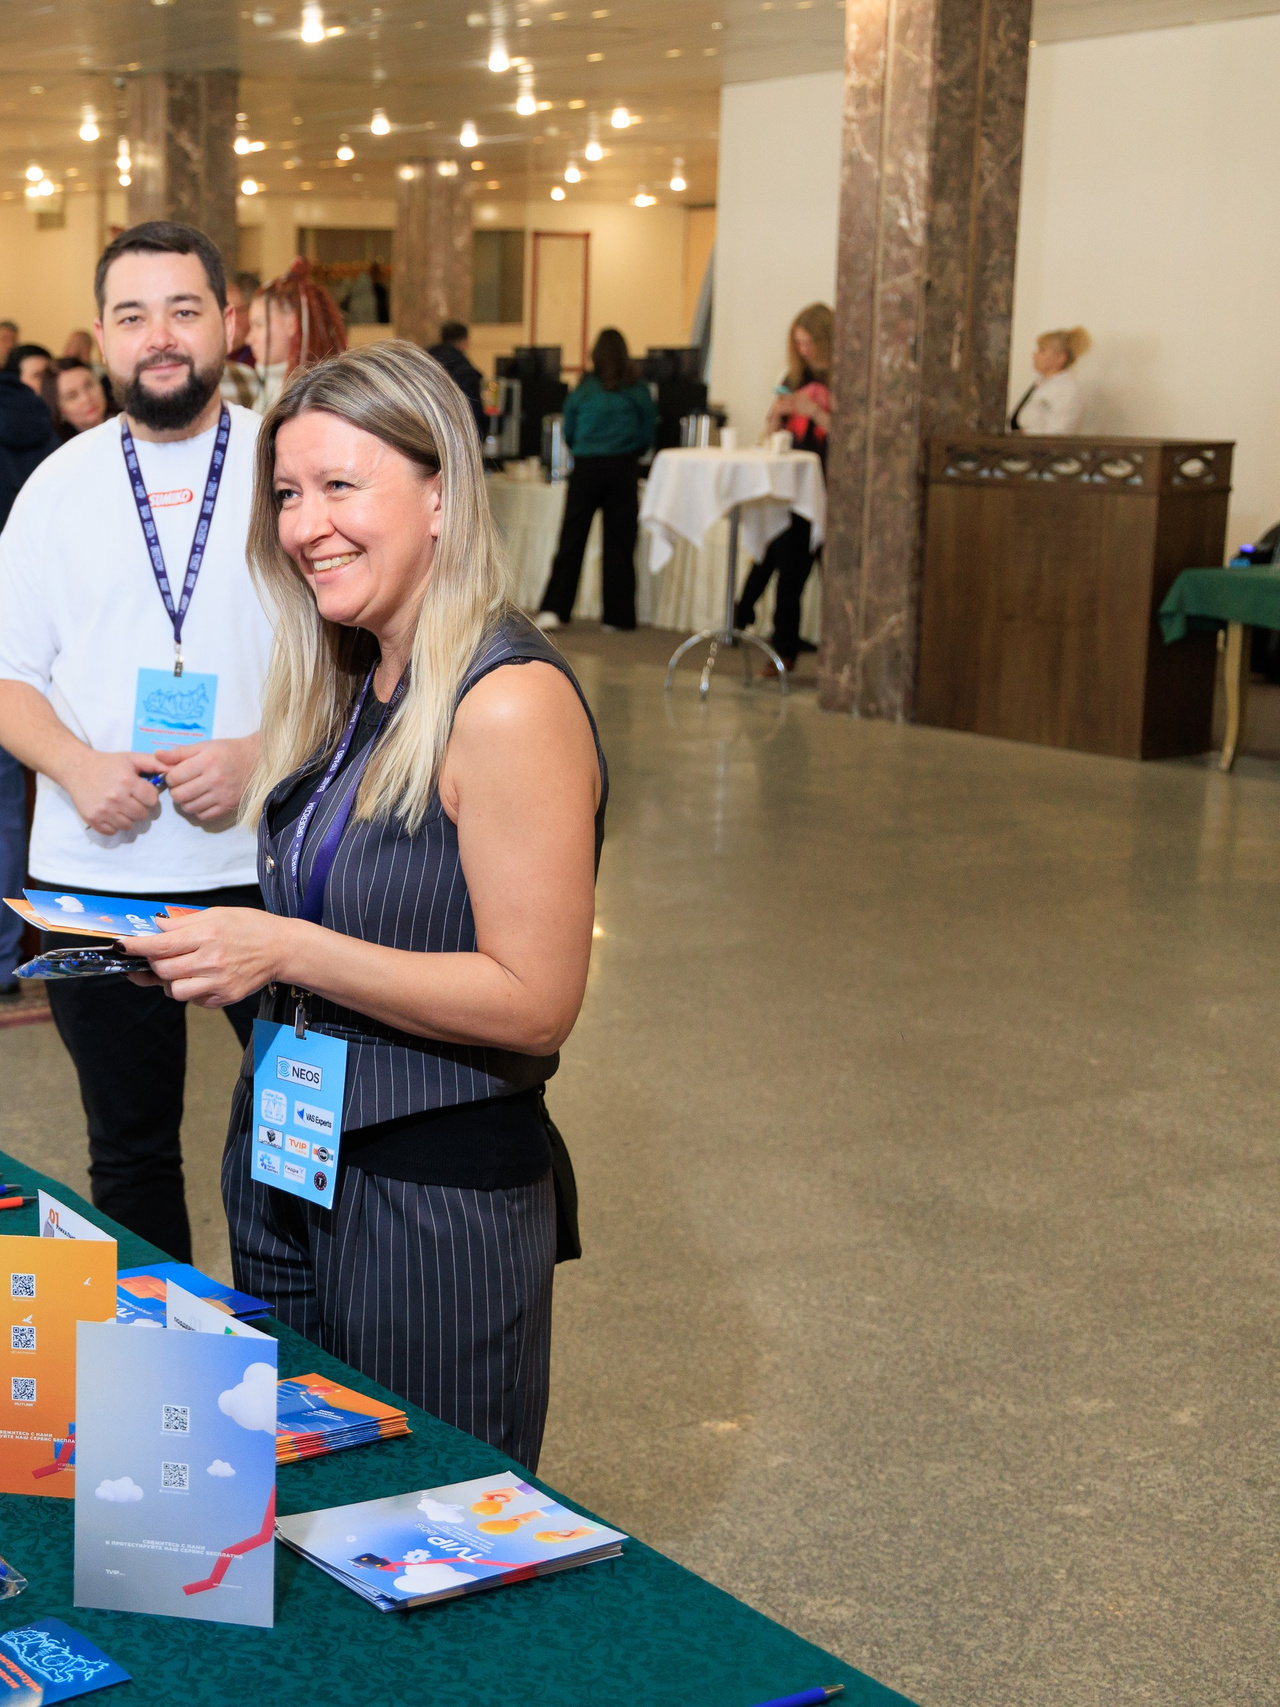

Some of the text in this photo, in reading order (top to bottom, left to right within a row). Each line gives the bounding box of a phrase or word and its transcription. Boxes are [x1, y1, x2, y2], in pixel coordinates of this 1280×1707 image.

[297, 801, 317, 838] ORDERCOM
[330, 749, 345, 772] ПРАВО
[292, 1066, 320, 1084] NEOS
[306, 1112, 332, 1129] VAS Experts
[288, 1138, 307, 1150] TVIP
[111, 1540, 163, 1551] ПРОТЕСТИРУЙТЕ
[205, 1550, 244, 1559] БЕСПЛАТНО
[142, 1539, 180, 1548] СВЯЖИТЕСЬ
[427, 1536, 483, 1563] TVIP
